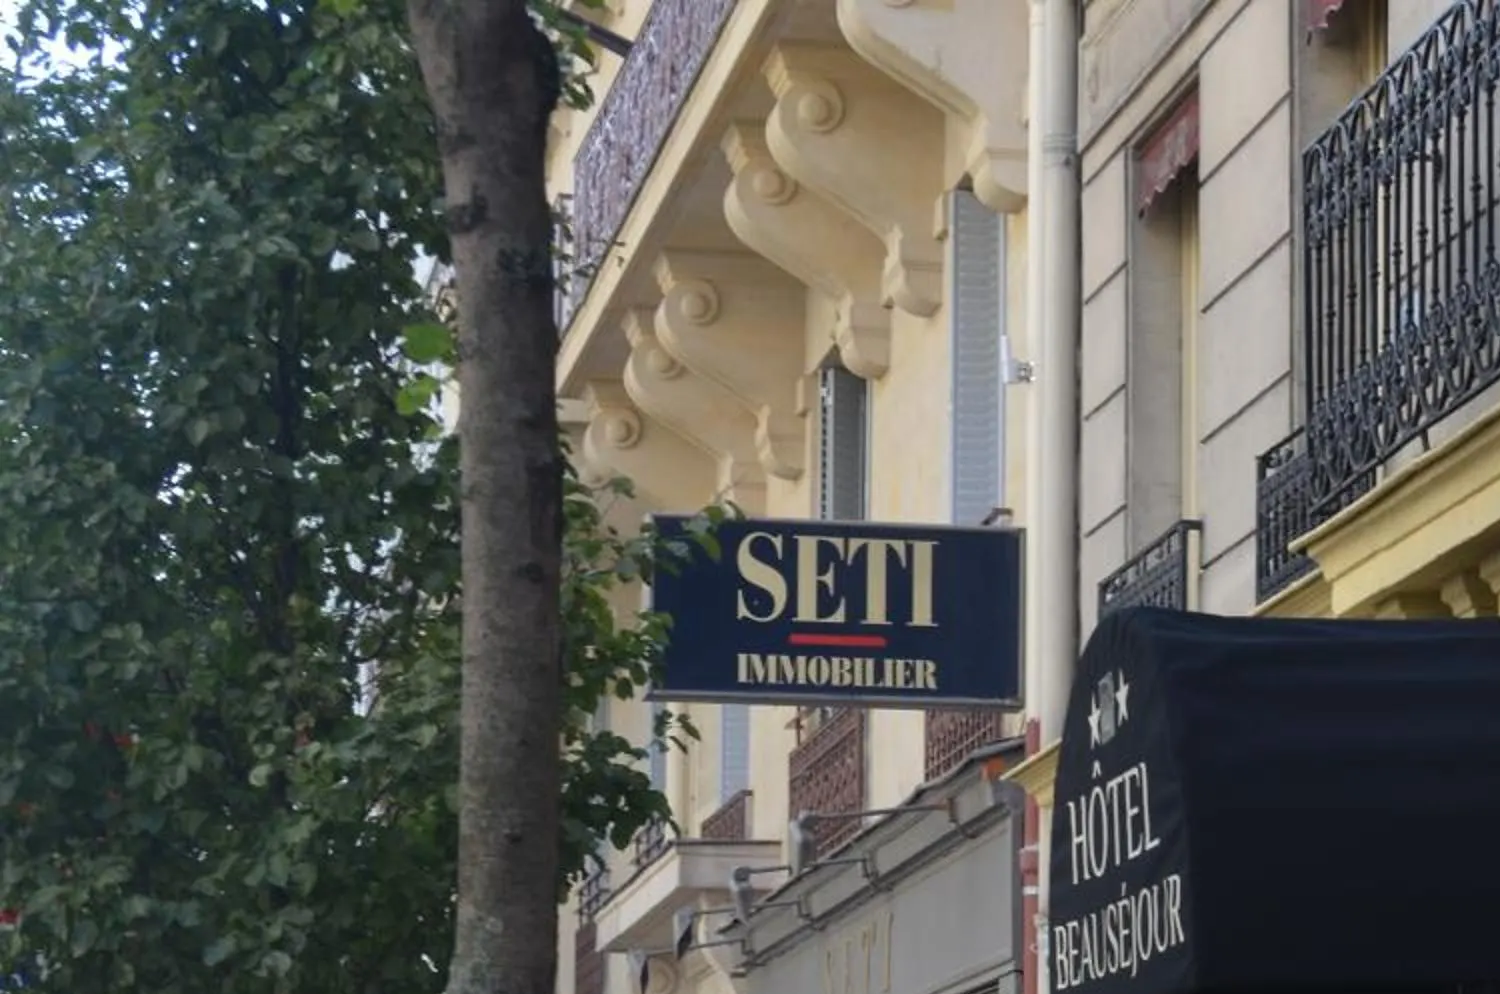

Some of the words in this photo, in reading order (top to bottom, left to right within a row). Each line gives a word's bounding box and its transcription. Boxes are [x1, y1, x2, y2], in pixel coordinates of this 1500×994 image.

[736, 531, 941, 628] SETI
[737, 652, 938, 690] IMMOBILIER
[1067, 759, 1161, 885] HÔTEL
[1053, 873, 1185, 991] BEAUSÉJOUR
